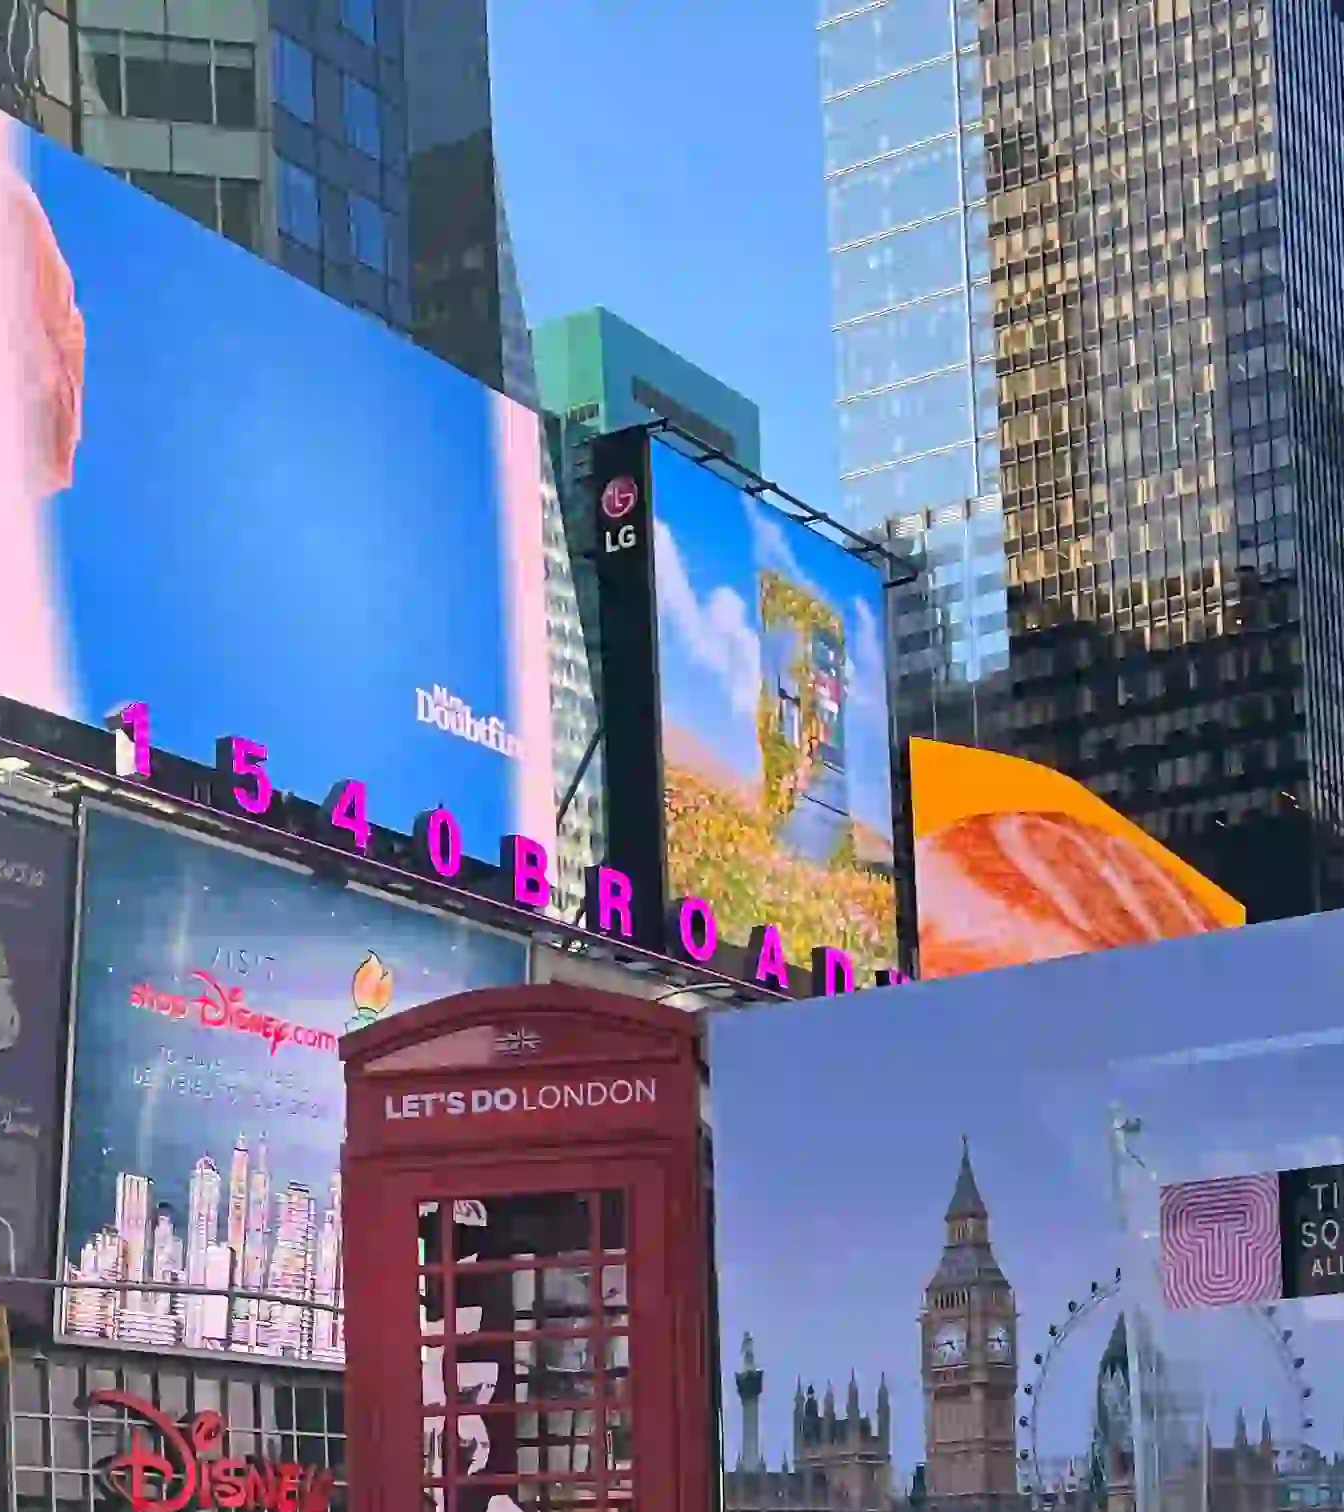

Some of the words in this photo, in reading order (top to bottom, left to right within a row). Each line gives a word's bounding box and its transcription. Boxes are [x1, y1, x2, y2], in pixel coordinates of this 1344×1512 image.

[605, 525, 637, 552] LG
[108, 699, 462, 877] 1540
[384, 1090, 465, 1120] LET'S
[472, 1087, 518, 1113] DO
[522, 1079, 657, 1111] LONDON
